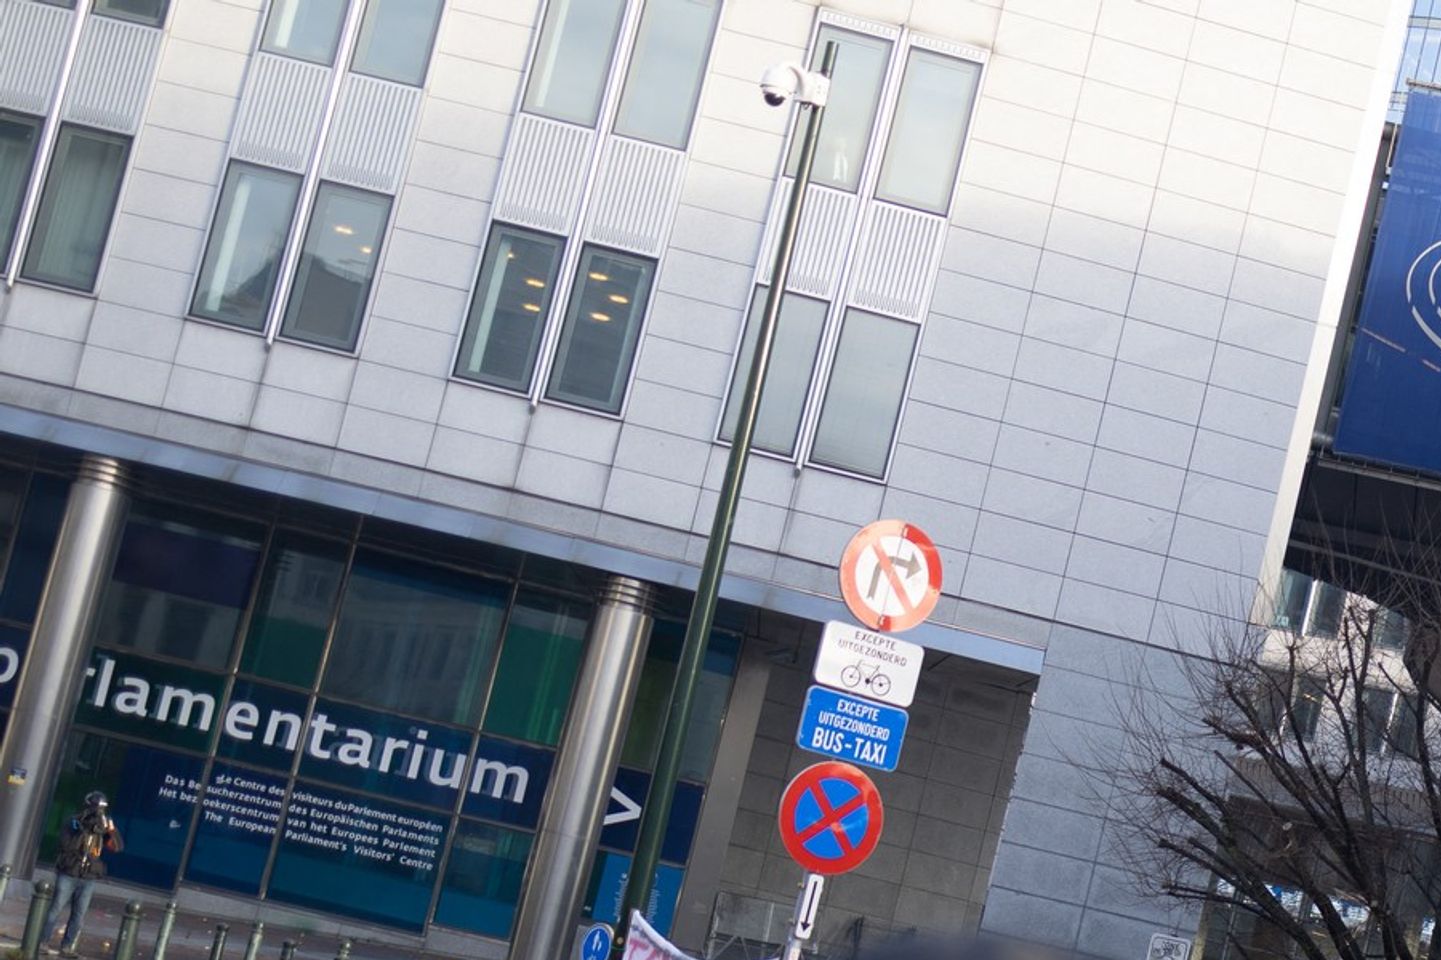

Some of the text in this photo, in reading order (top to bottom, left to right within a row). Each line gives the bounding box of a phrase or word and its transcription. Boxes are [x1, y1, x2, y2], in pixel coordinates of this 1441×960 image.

[838, 639, 907, 667] UITGEZONDERD
[855, 630, 897, 651] EXCEPTE
[818, 711, 890, 742] UITGEZONDERD
[837, 699, 880, 721] EXCEPTE
[165, 774, 185, 787] Das
[288, 803, 307, 815] des
[310, 809, 379, 831] Europäischen
[382, 825, 439, 845] Parlaments
[233, 777, 267, 792] Centre
[268, 783, 285, 796] des
[292, 791, 333, 807] visiteurs
[334, 801, 347, 811] du
[348, 803, 396, 822] Parlement
[159, 787, 177, 799] Het
[286, 817, 307, 828] van
[310, 822, 328, 833] het
[331, 827, 379, 845] Europees
[382, 839, 436, 858] Parlement
[205, 810, 223, 822] The
[228, 817, 277, 834] European
[399, 855, 434, 871] Centre
